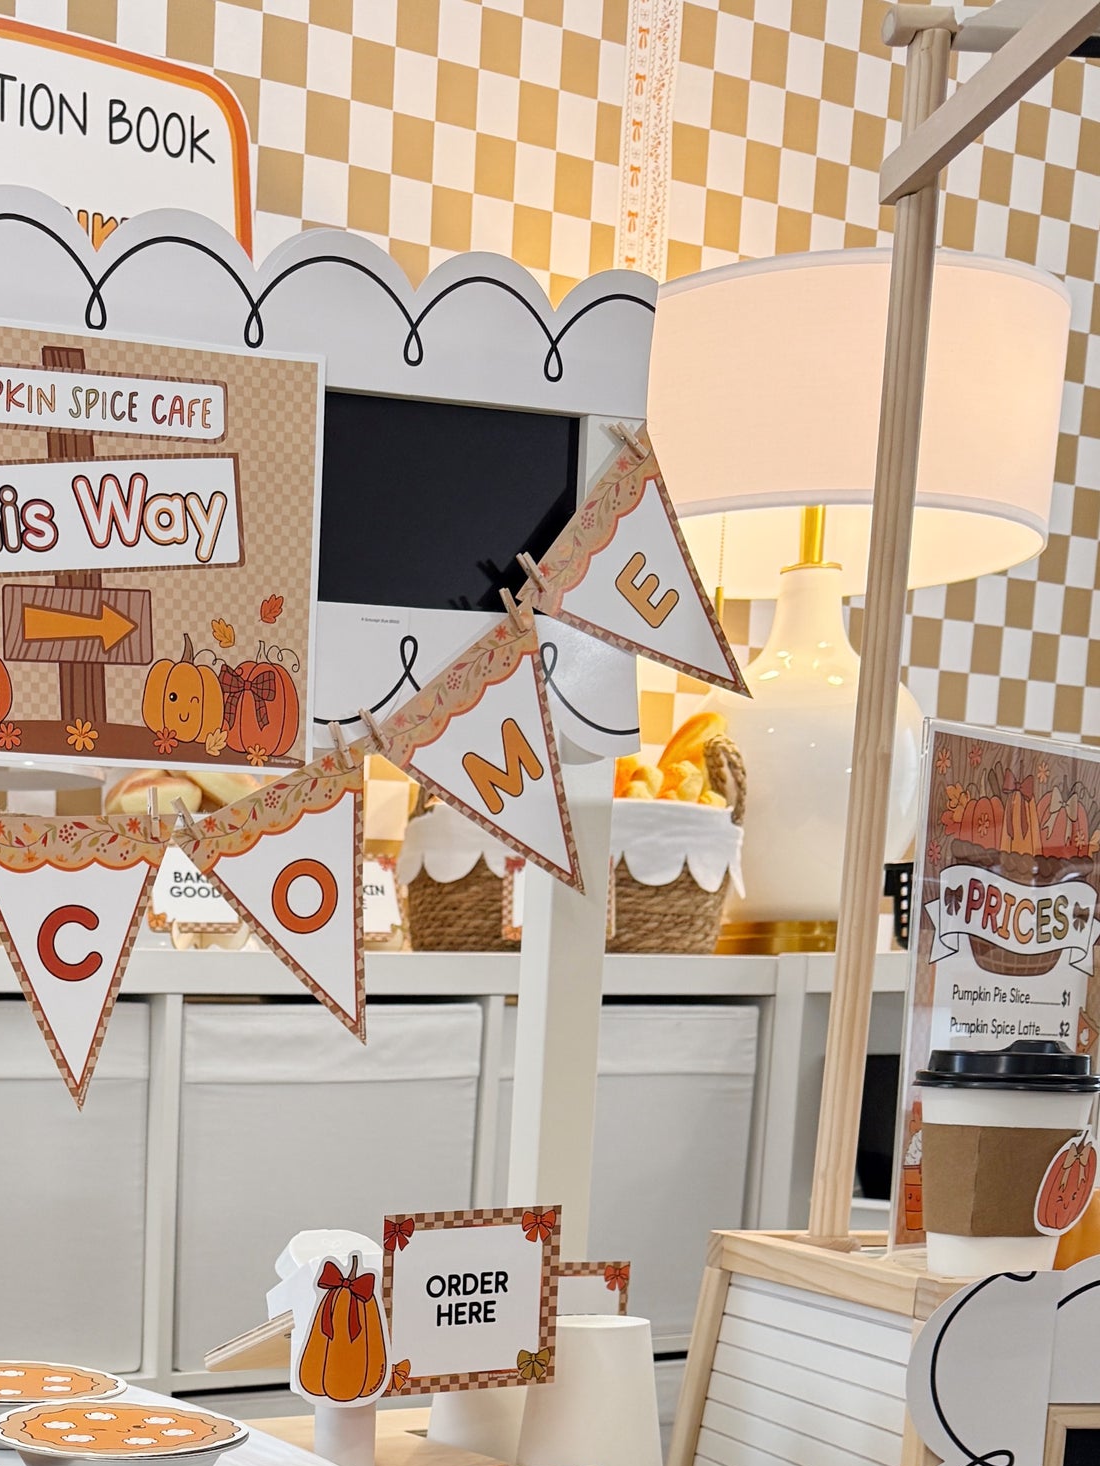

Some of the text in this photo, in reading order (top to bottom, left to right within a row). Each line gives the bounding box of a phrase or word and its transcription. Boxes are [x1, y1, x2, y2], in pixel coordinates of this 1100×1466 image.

[108, 99, 216, 165] BOOK
[68, 386, 139, 422] SPICE
[151, 394, 213, 429] CAFE
[71, 473, 228, 563] Way
[965, 878, 1069, 945] PRICES
[952, 984, 1071, 1008] Pumpkin Pie Slice $1
[950, 1017, 1070, 1039] Pumpkin Spice Latte $2
[426, 1271, 509, 1298] ORDER
[436, 1300, 497, 1327] HERE
